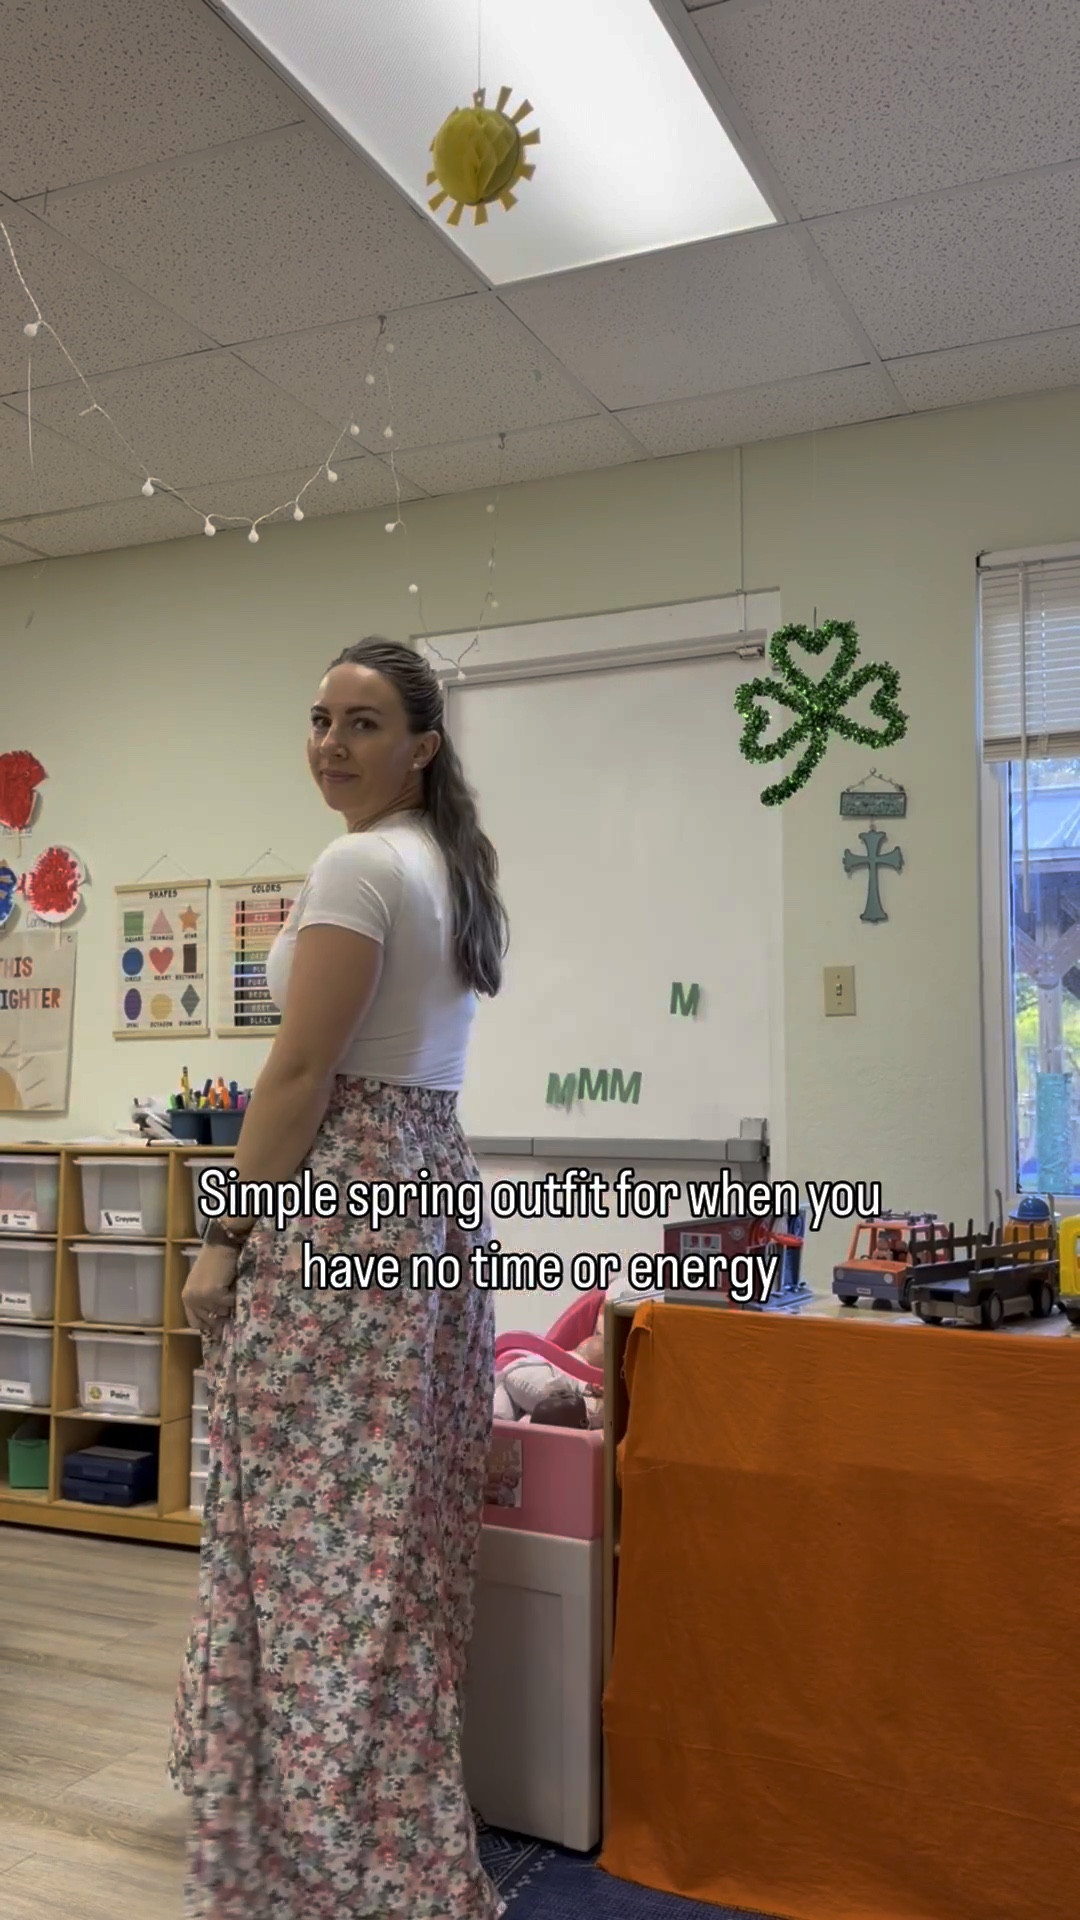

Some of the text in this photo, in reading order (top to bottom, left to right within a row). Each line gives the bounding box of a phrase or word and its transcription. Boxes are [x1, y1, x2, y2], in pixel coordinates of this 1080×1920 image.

[252, 884, 281, 893] COLORS
[149, 889, 177, 899] SHAPES
[670, 982, 700, 1016] M
[250, 1016, 273, 1025] BLACK
[115, 1215, 140, 1225] Crayons
[110, 1390, 130, 1400] Paint
